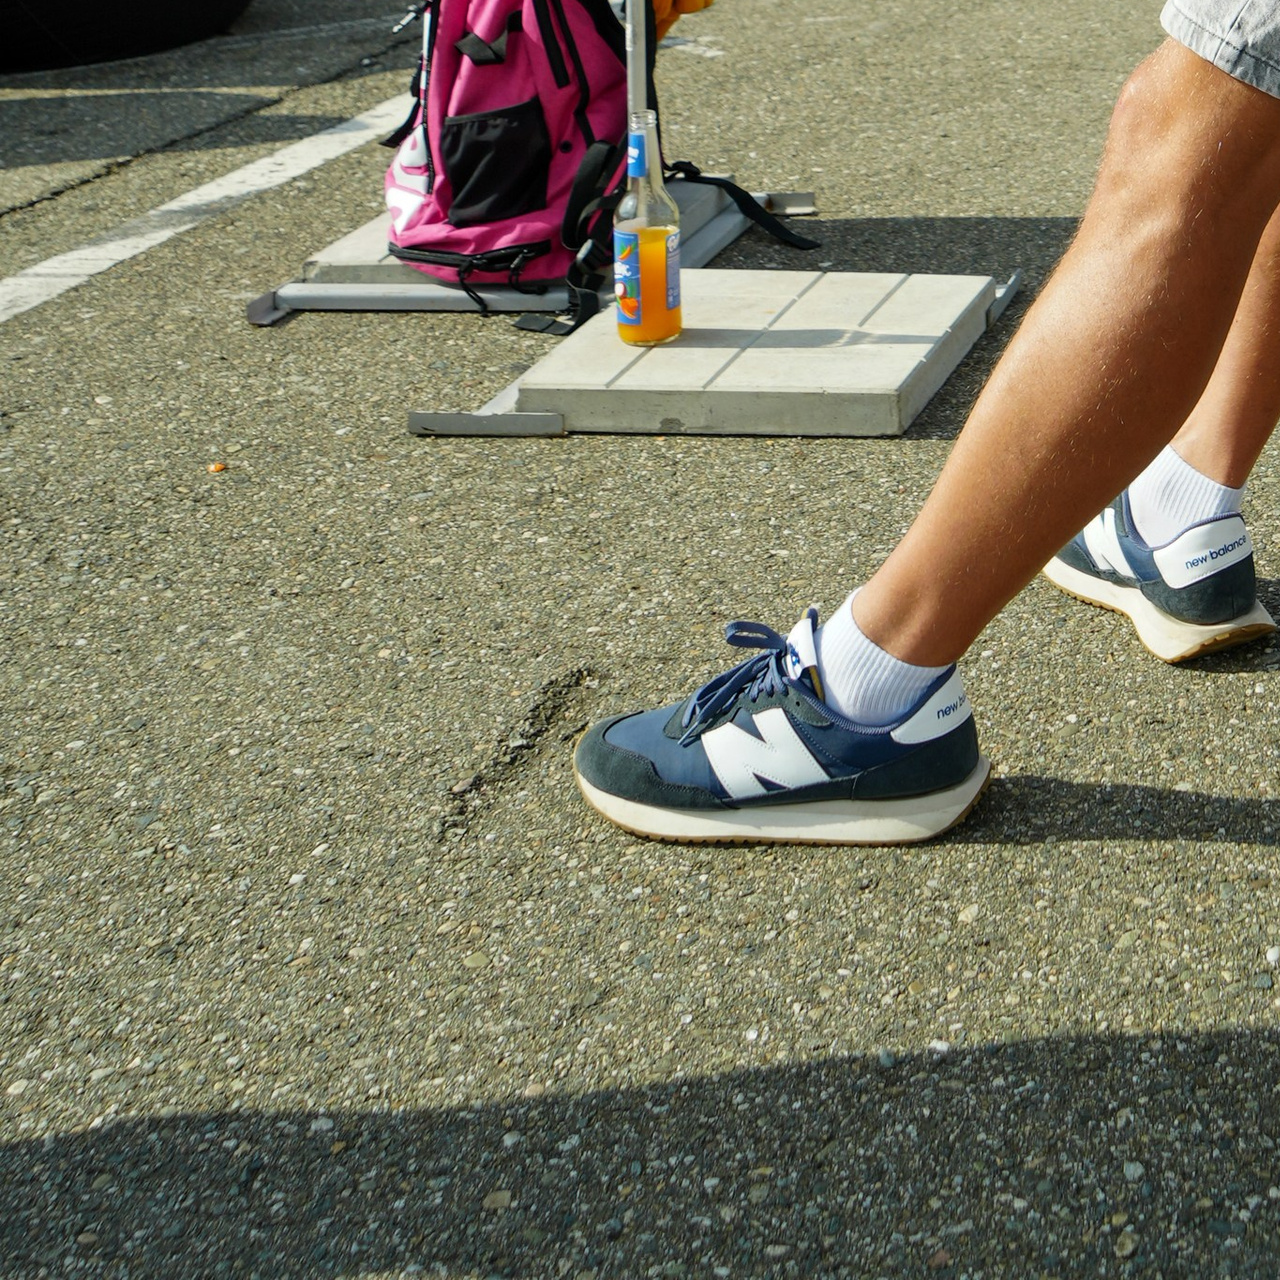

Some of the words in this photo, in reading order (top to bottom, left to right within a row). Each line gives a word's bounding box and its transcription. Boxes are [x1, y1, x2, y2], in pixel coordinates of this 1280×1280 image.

[1185, 554, 1208, 570] new
[1208, 534, 1247, 560] balance
[936, 700, 959, 720] new
